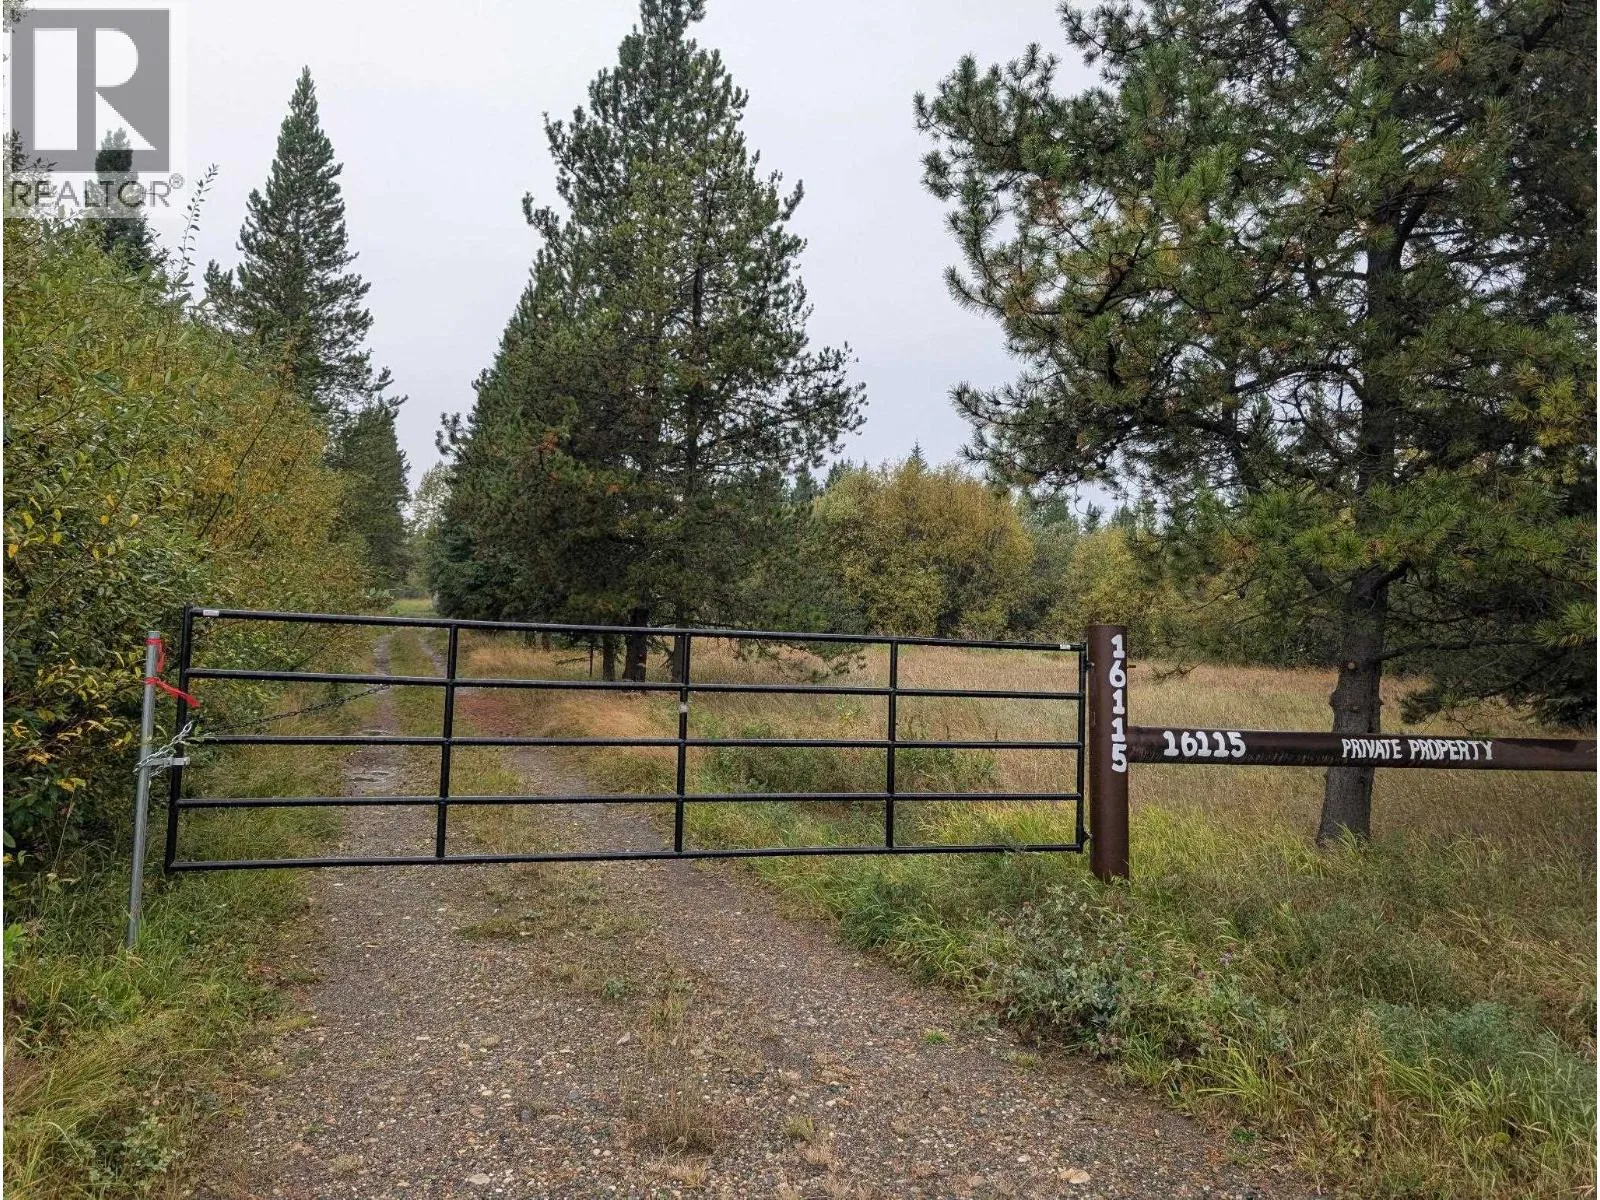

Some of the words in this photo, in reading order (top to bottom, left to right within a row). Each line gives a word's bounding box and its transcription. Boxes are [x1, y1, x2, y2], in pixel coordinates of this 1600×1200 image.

[1109, 634, 1127, 772] 16115
[1162, 730, 1247, 758] 16115
[1341, 738, 1402, 759] PRIVATE
[1407, 739, 1493, 760] PROPERTY
